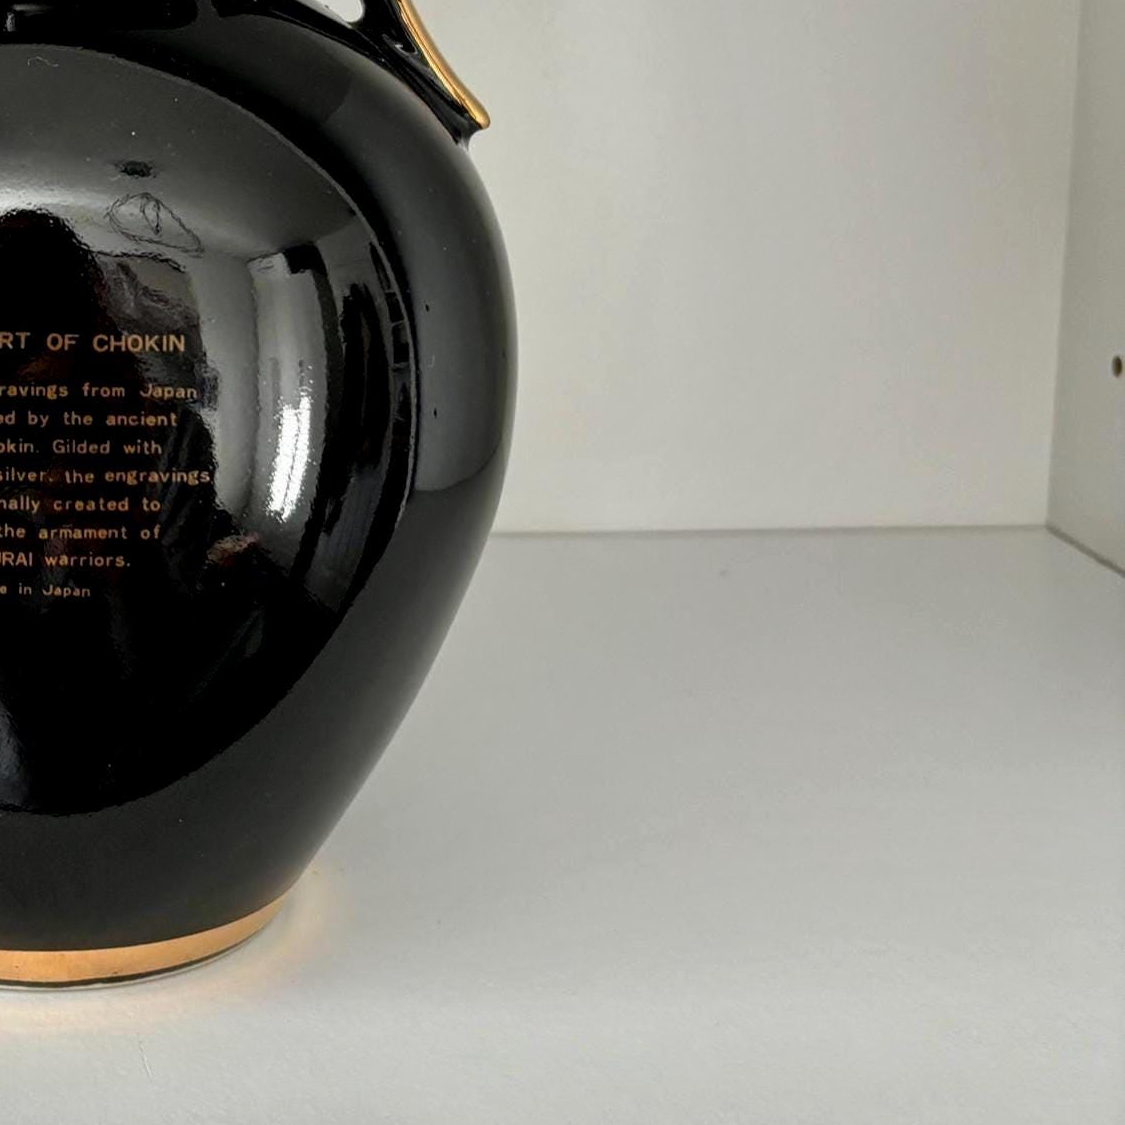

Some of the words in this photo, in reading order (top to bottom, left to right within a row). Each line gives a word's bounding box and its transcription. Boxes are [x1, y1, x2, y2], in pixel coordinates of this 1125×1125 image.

[46, 333, 79, 351] OF
[93, 334, 186, 353] CHOKIN
[82, 383, 125, 397] from
[139, 384, 197, 400] Japan
[27, 411, 49, 426] by
[64, 412, 93, 426] the
[106, 412, 177, 426] ancient
[53, 440, 110, 454] Gilded
[124, 441, 162, 454] with
[65, 469, 94, 484] the
[105, 469, 210, 485] engravings
[53, 497, 129, 512] created
[143, 497, 161, 511] to
[38, 527, 127, 540] armament
[141, 525, 160, 539] of
[44, 554, 131, 567] warriors.
[19, 583, 32, 595] in
[43, 584, 91, 597] Japan
